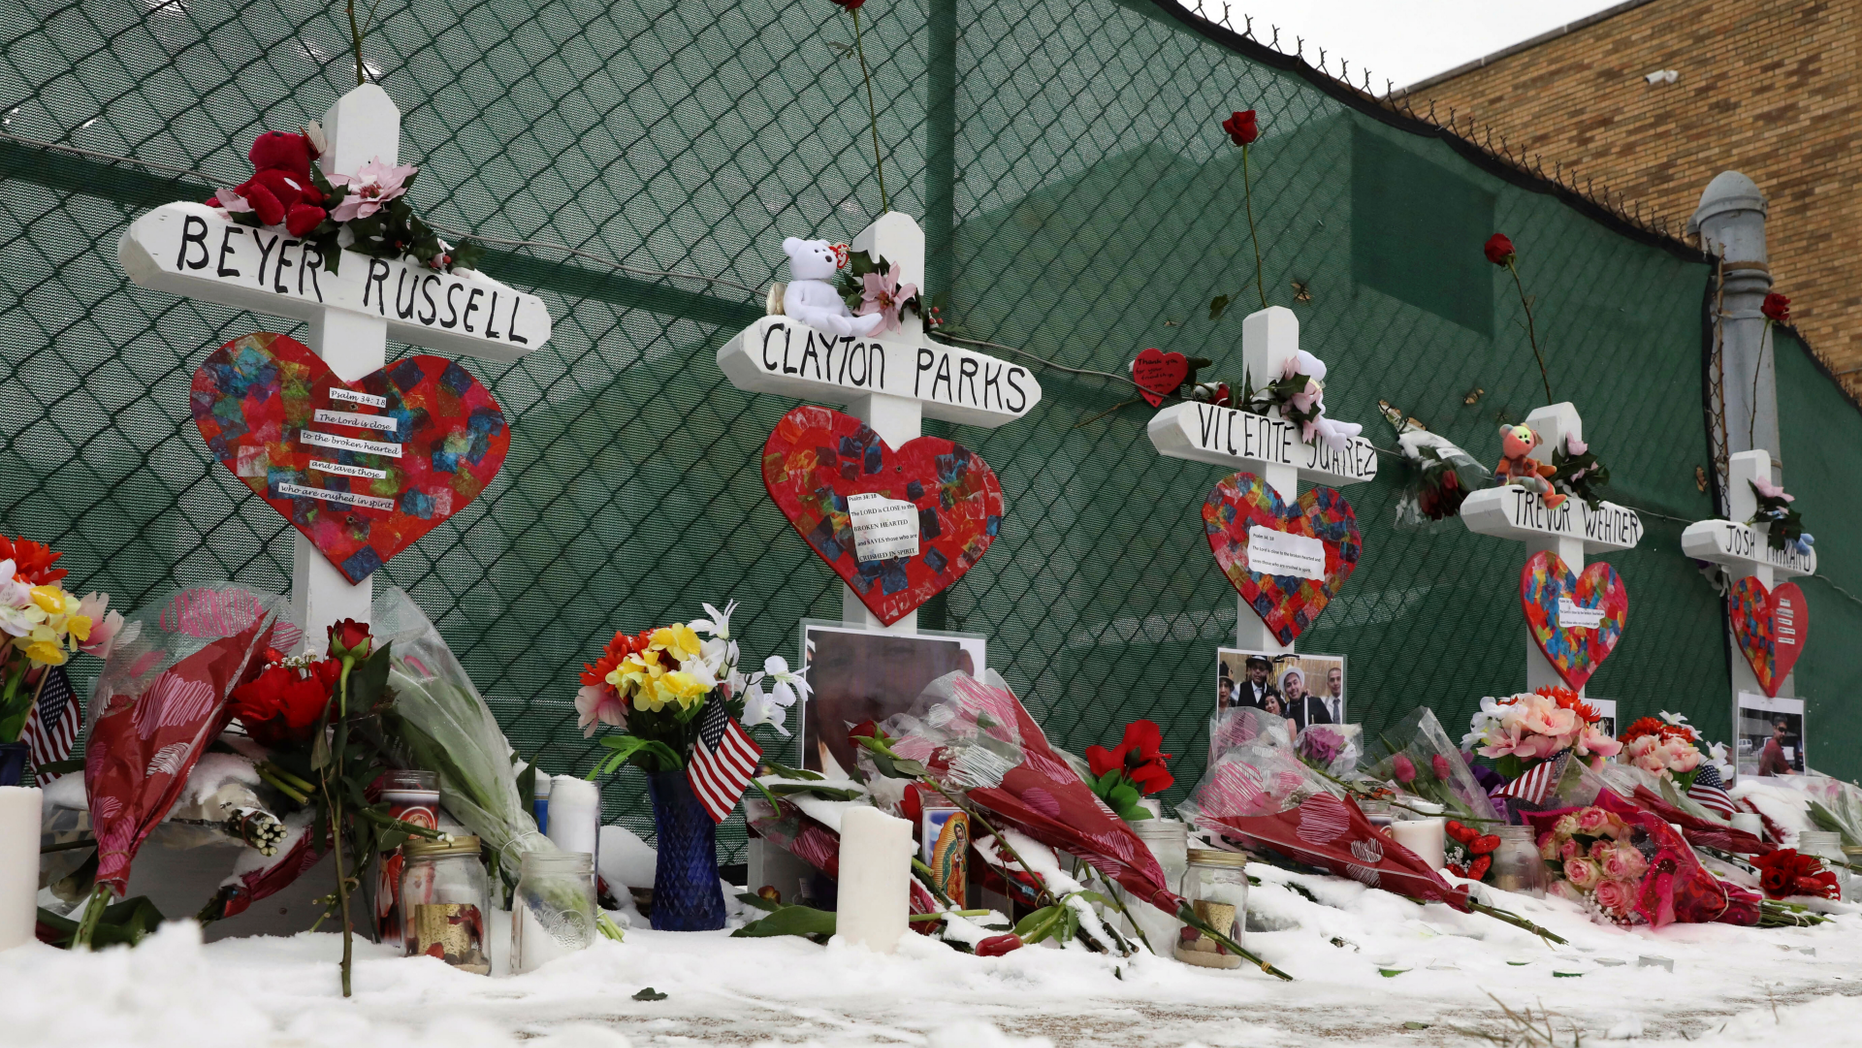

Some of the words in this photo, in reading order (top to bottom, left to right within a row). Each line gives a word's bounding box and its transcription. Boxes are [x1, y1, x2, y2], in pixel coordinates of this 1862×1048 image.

[176, 214, 323, 303] BEYER
[363, 258, 528, 345] RUSSELL
[762, 323, 886, 390] CLAYTON
[914, 347, 1026, 413] PARKS
[331, 390, 359, 401] Psalm
[376, 398, 386, 406] 18
[319, 413, 337, 422] The
[338, 417, 359, 426] Lord
[369, 420, 392, 430] close
[1198, 403, 1295, 464] VICENTE
[314, 433, 330, 443] the
[331, 436, 363, 448] broken
[363, 442, 400, 455] hearted
[312, 461, 333, 470] and
[333, 464, 356, 475] saves
[356, 468, 381, 478] those
[281, 484, 301, 493] who
[320, 492, 356, 503] crushed
[357, 497, 368, 505] in
[860, 508, 877, 516] LORD
[882, 505, 900, 513] CLOSE
[1512, 489, 1571, 532] TREVOR
[1581, 502, 1639, 544] WEHNER
[854, 523, 879, 532] BROKEN
[880, 519, 908, 529] HEARTED
[866, 538, 885, 546] SAVES
[1726, 525, 1756, 559] JOSH
[859, 552, 888, 561] CRUSHED
